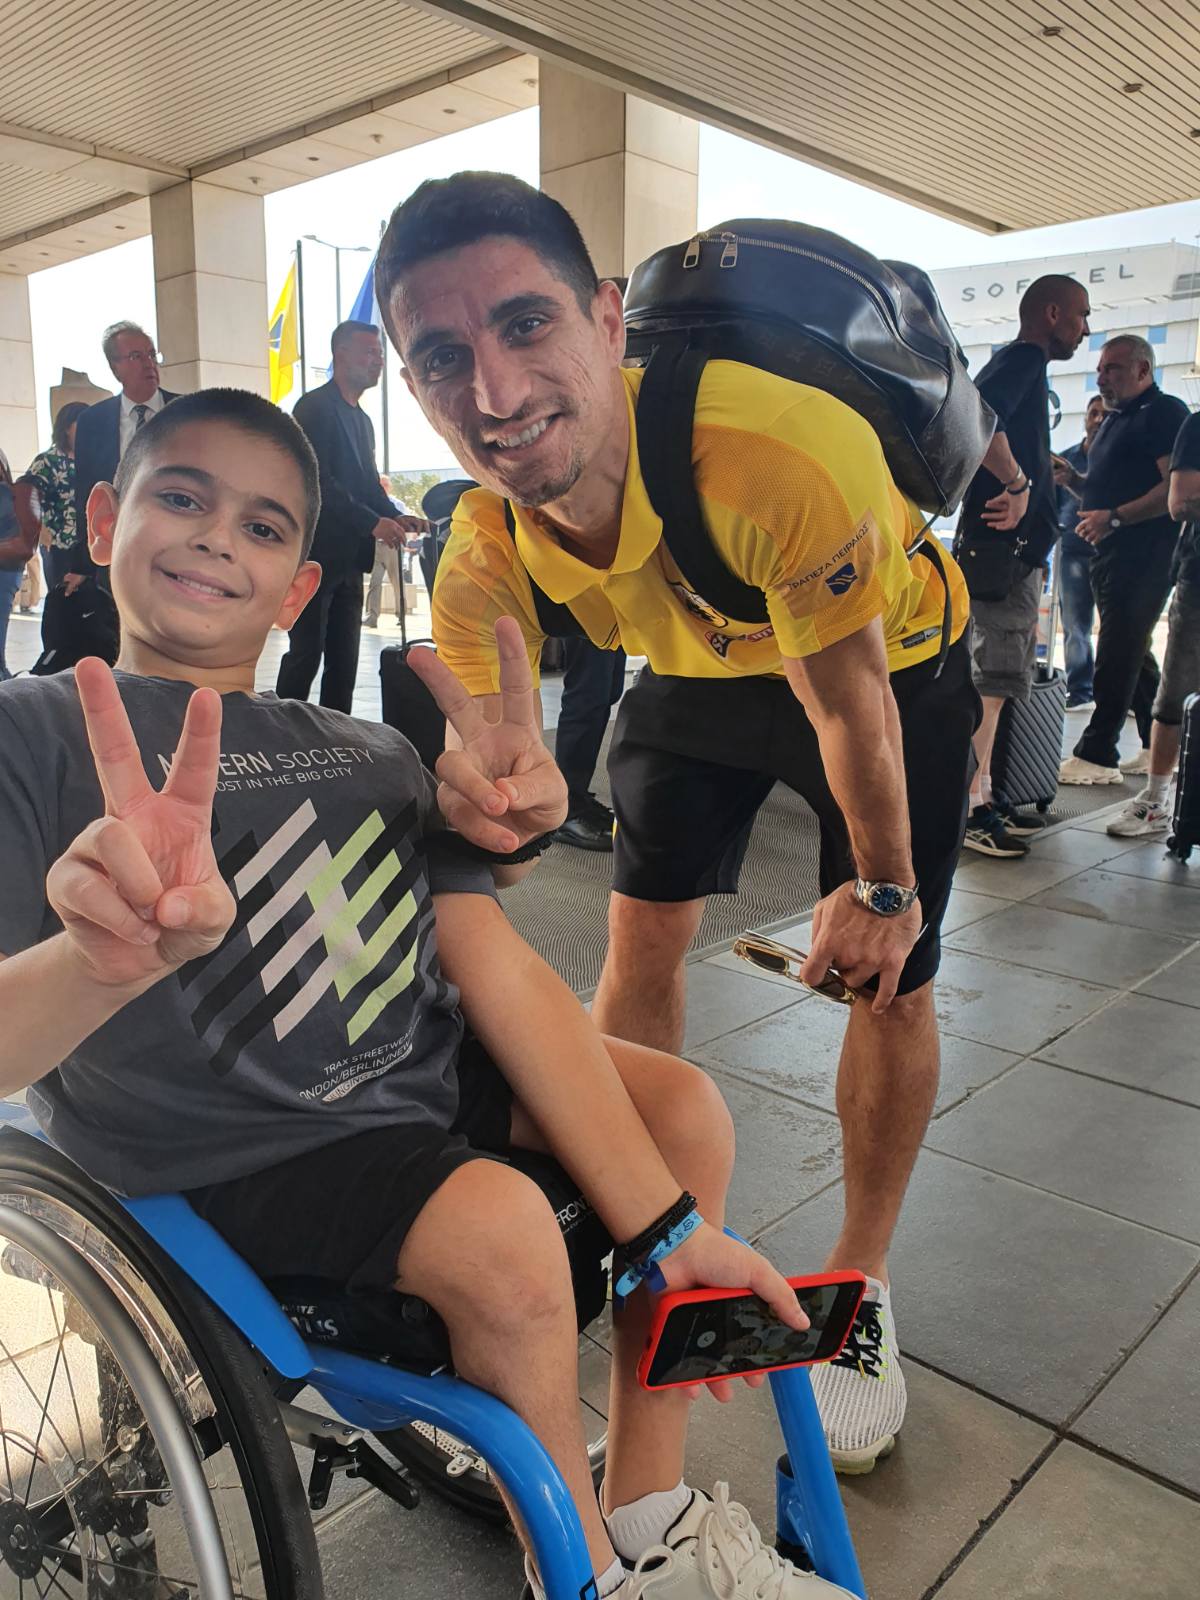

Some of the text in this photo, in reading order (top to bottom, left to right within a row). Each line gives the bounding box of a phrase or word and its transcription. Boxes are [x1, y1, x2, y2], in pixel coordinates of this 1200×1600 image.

[961, 263, 1135, 302] SOFEL
[275, 747, 375, 770] SOCIETY
[246, 778, 263, 789] IN
[266, 775, 294, 787] THE
[295, 771, 321, 783] BIG
[323, 766, 354, 780] CITY
[323, 1058, 349, 1076] TRAX
